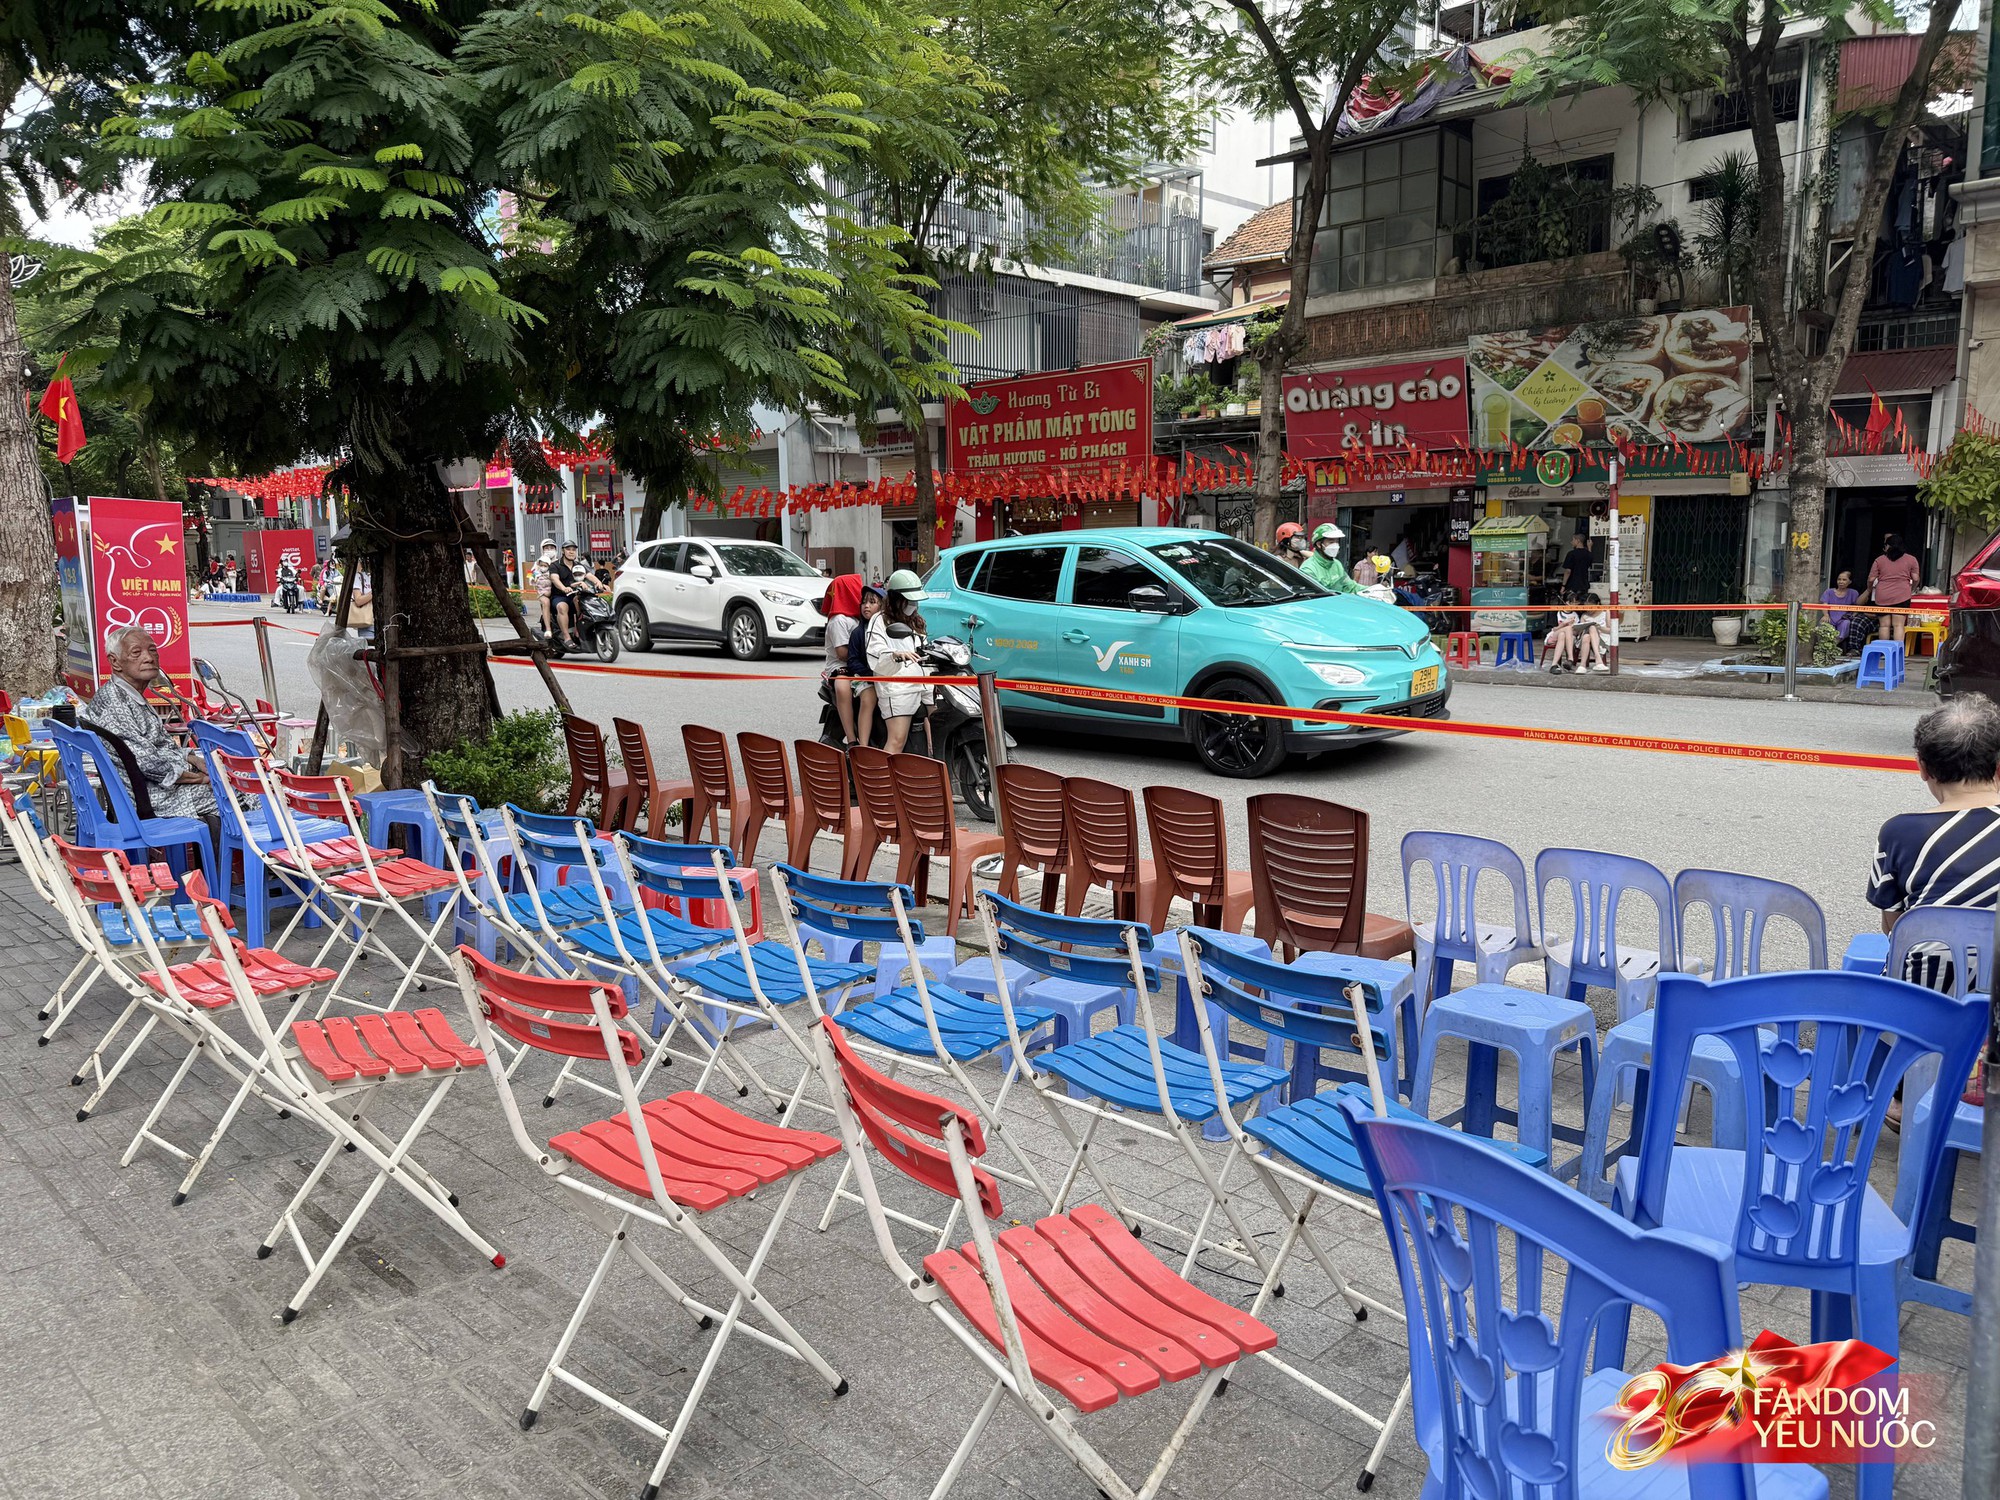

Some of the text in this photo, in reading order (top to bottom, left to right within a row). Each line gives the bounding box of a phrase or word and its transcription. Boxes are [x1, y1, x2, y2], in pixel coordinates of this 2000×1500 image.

[1008, 381, 1100, 410] Hương Từ Bi
[1286, 367, 1461, 413] Quảng cáo
[1546, 384, 1567, 394] bánh
[958, 407, 1136, 449] VẬT PHẨM MẬT TÔNG
[1341, 423, 1365, 448] &
[967, 449, 1000, 468] TRẦM
[1003, 450, 1046, 465] HƯƠNG
[1060, 440, 1078, 460] HỔ
[1082, 438, 1127, 458] PHÁCH
[121, 577, 181, 592] VIỆT NAM
[1118, 656, 1151, 668] XANH SM
[1524, 730, 1546, 739] HÀNG
[1548, 732, 1565, 740] RÀO
[1567, 733, 1590, 742] CẢNH
[1612, 736, 1631, 746] CẤM
[1633, 739, 1658, 748] VƯỢT
[1688, 745, 1720, 753] POLICE
[1723, 747, 1746, 756] LINE.
[1787, 753, 1820, 762] CROSS
